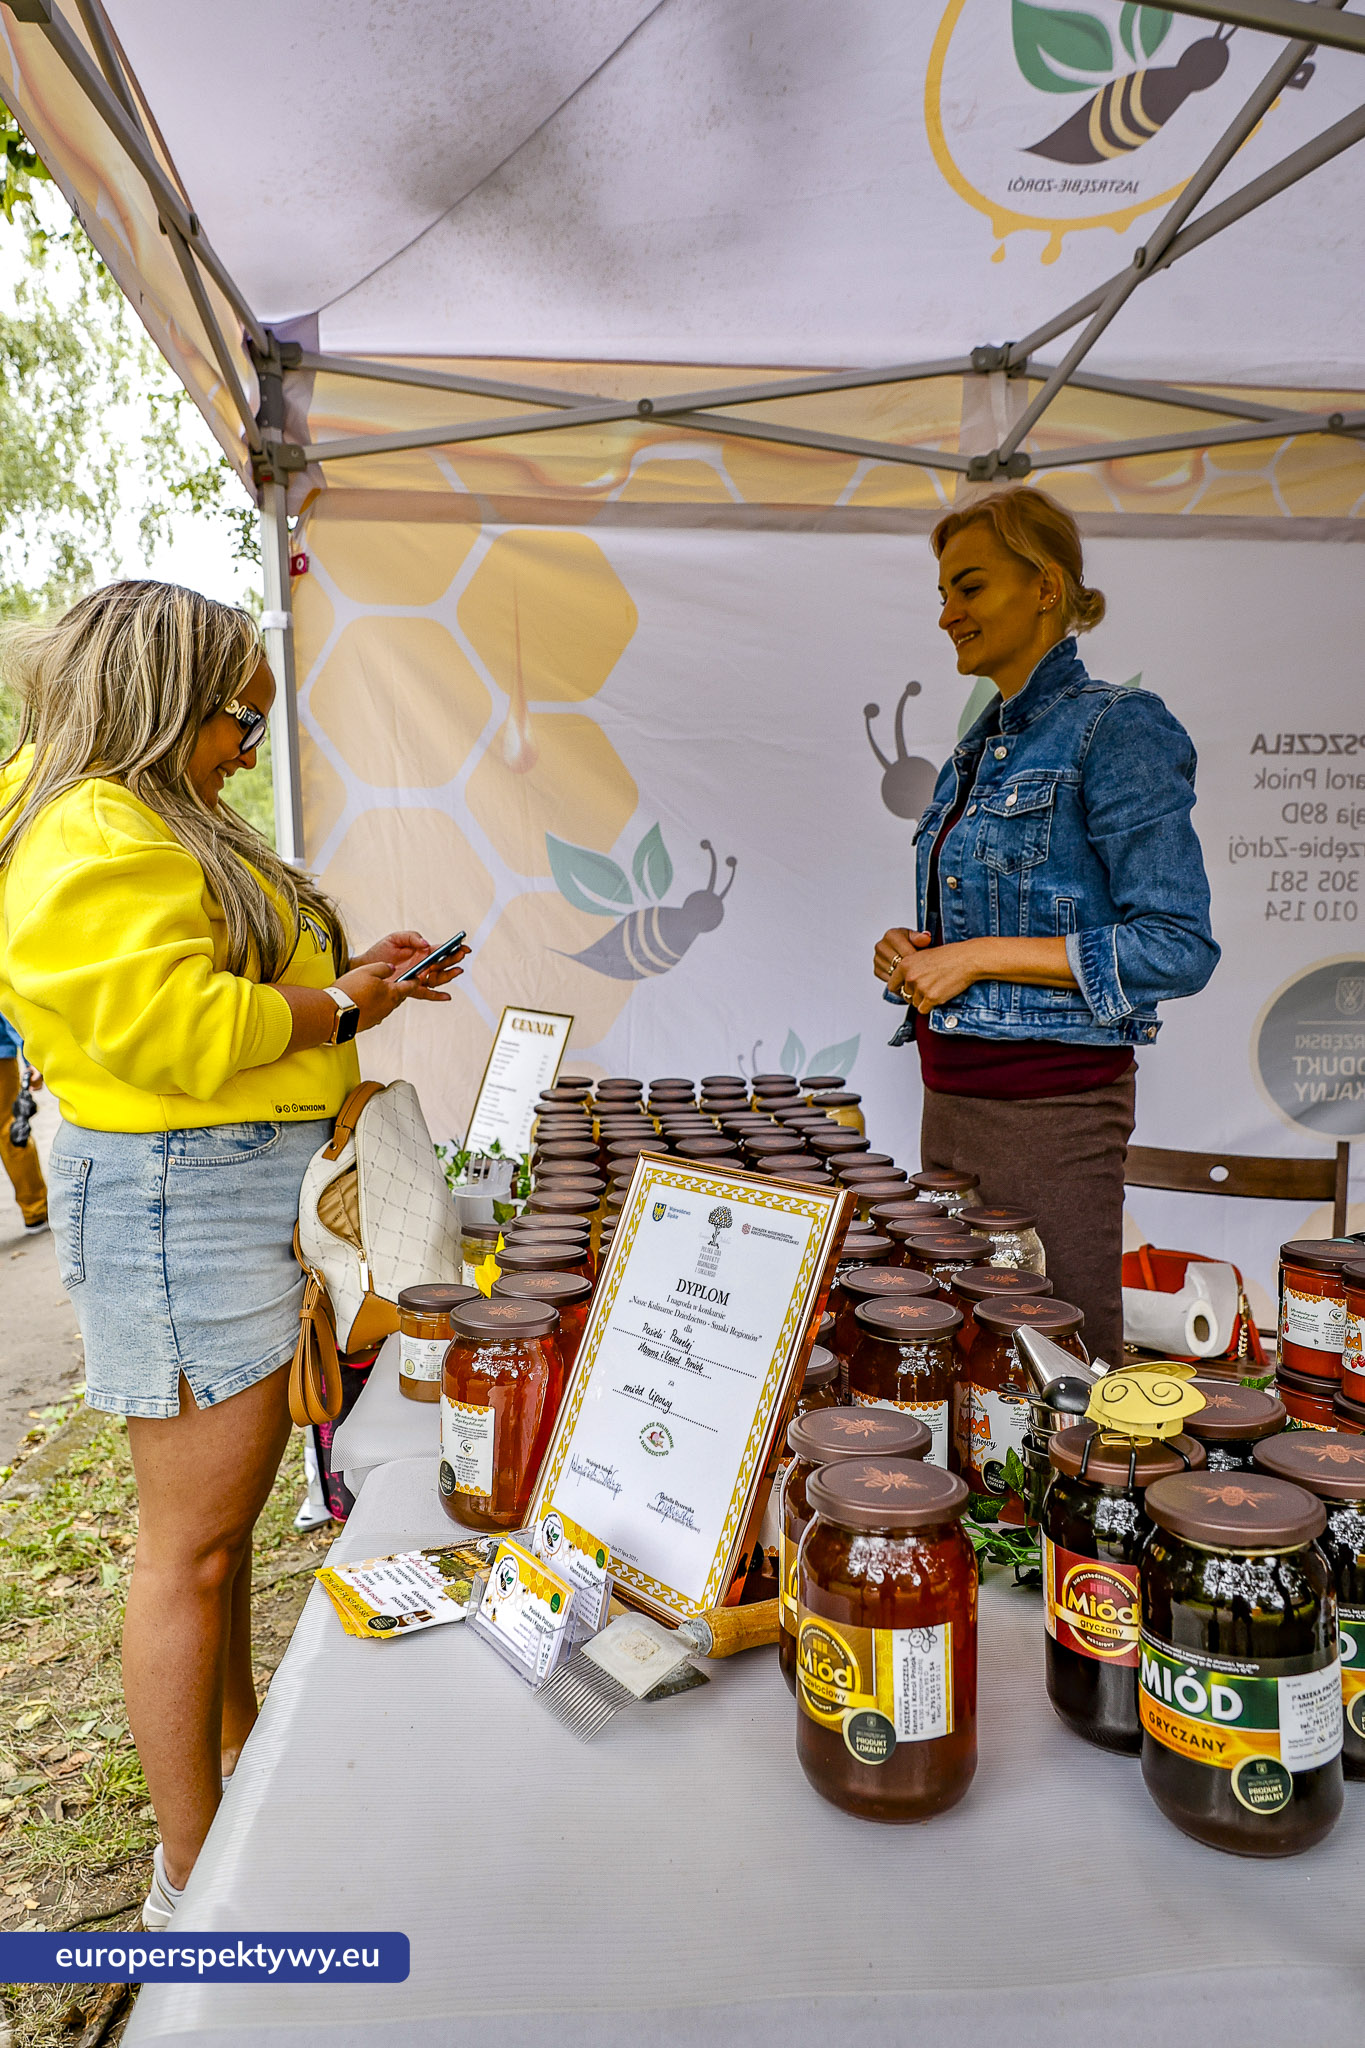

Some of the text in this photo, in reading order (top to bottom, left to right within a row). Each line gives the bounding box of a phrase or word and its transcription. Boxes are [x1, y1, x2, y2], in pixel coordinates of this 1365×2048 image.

[512, 1018, 556, 1036] CENNIK
[675, 1278, 731, 1306] DYPLOM
[648, 1301, 673, 1316] Kulinarne
[674, 1309, 707, 1325] Dziedzictwo
[711, 1321, 729, 1333] Smaki
[671, 1296, 692, 1310] nagroda
[698, 1303, 726, 1319] konkursie
[684, 1325, 693, 1334] dla
[1346, 1329, 1362, 1351] ód
[971, 1410, 991, 1440] ód
[1114, 1581, 1130, 1599] Polska
[1068, 1587, 1138, 1625] Miód
[1080, 1619, 1123, 1636] gryczany
[801, 1642, 852, 1690] Miód
[1141, 1651, 1243, 1722] MIÓD
[856, 1736, 887, 1747] PRODUKT
[1149, 1710, 1226, 1754] GRYCZANY
[856, 1743, 887, 1755] LOKALNY
[1249, 1784, 1282, 1795] PRODUKT
[1250, 1791, 1283, 1804] LOKALNY
